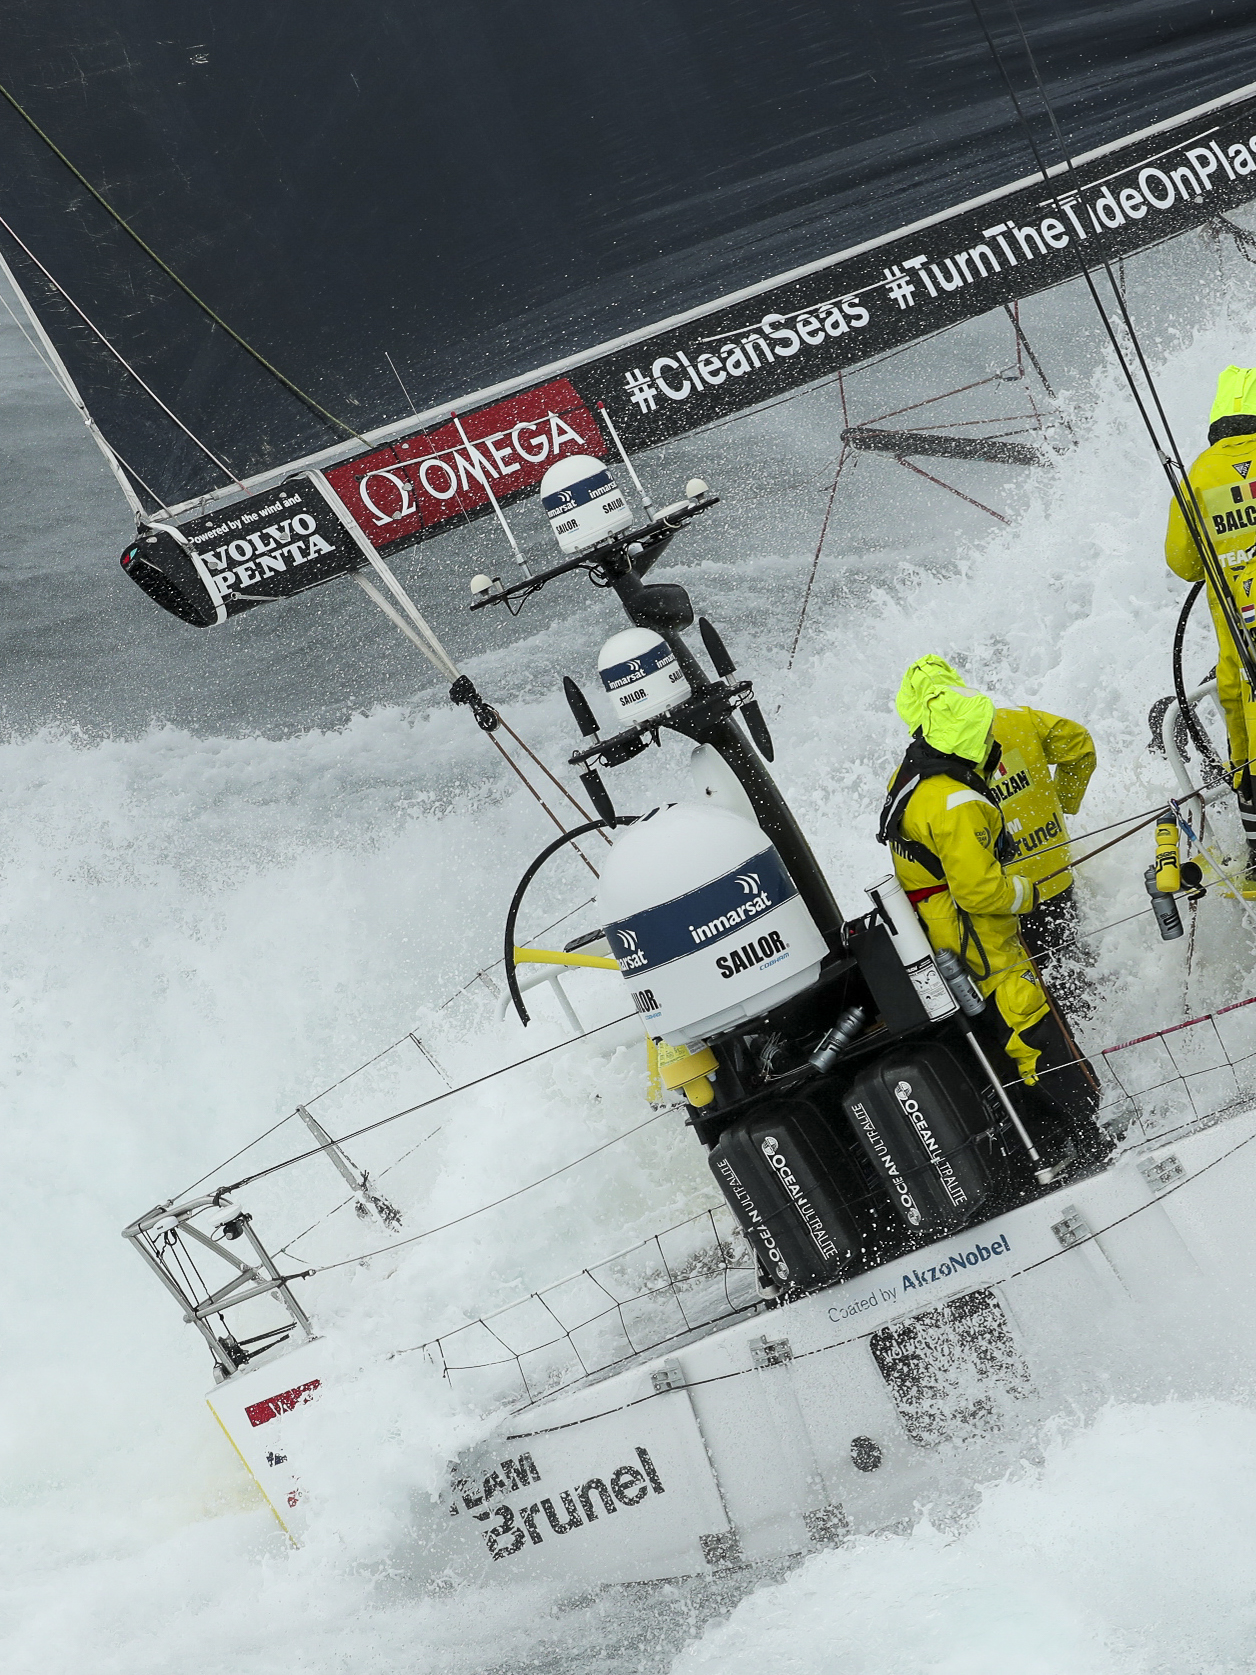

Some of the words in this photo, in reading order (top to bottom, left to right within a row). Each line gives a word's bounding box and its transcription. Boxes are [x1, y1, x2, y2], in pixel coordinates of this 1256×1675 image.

[624, 296, 870, 414] #CleanSeas
[419, 412, 586, 499] OMEGA
[188, 524, 229, 544] Powered
[228, 519, 242, 530] by
[241, 512, 259, 524] the
[259, 502, 283, 517] wind
[283, 493, 302, 508] and
[200, 513, 317, 570] VOLVO
[556, 518, 578, 535] SAILOR
[212, 533, 336, 597] PENTA
[607, 669, 646, 690] inmarsat
[619, 688, 647, 706] SAILOR
[990, 770, 1030, 803] OLZAN
[1013, 812, 1062, 857] runel
[689, 890, 772, 944] inmarsat
[716, 930, 786, 979] SAILOR
[905, 1100, 938, 1151] OCEAN
[828, 1292, 878, 1323] Coated
[879, 1286, 898, 1304] by
[902, 1233, 1011, 1293] AkzoNobel
[472, 1446, 665, 1562] Brunel
